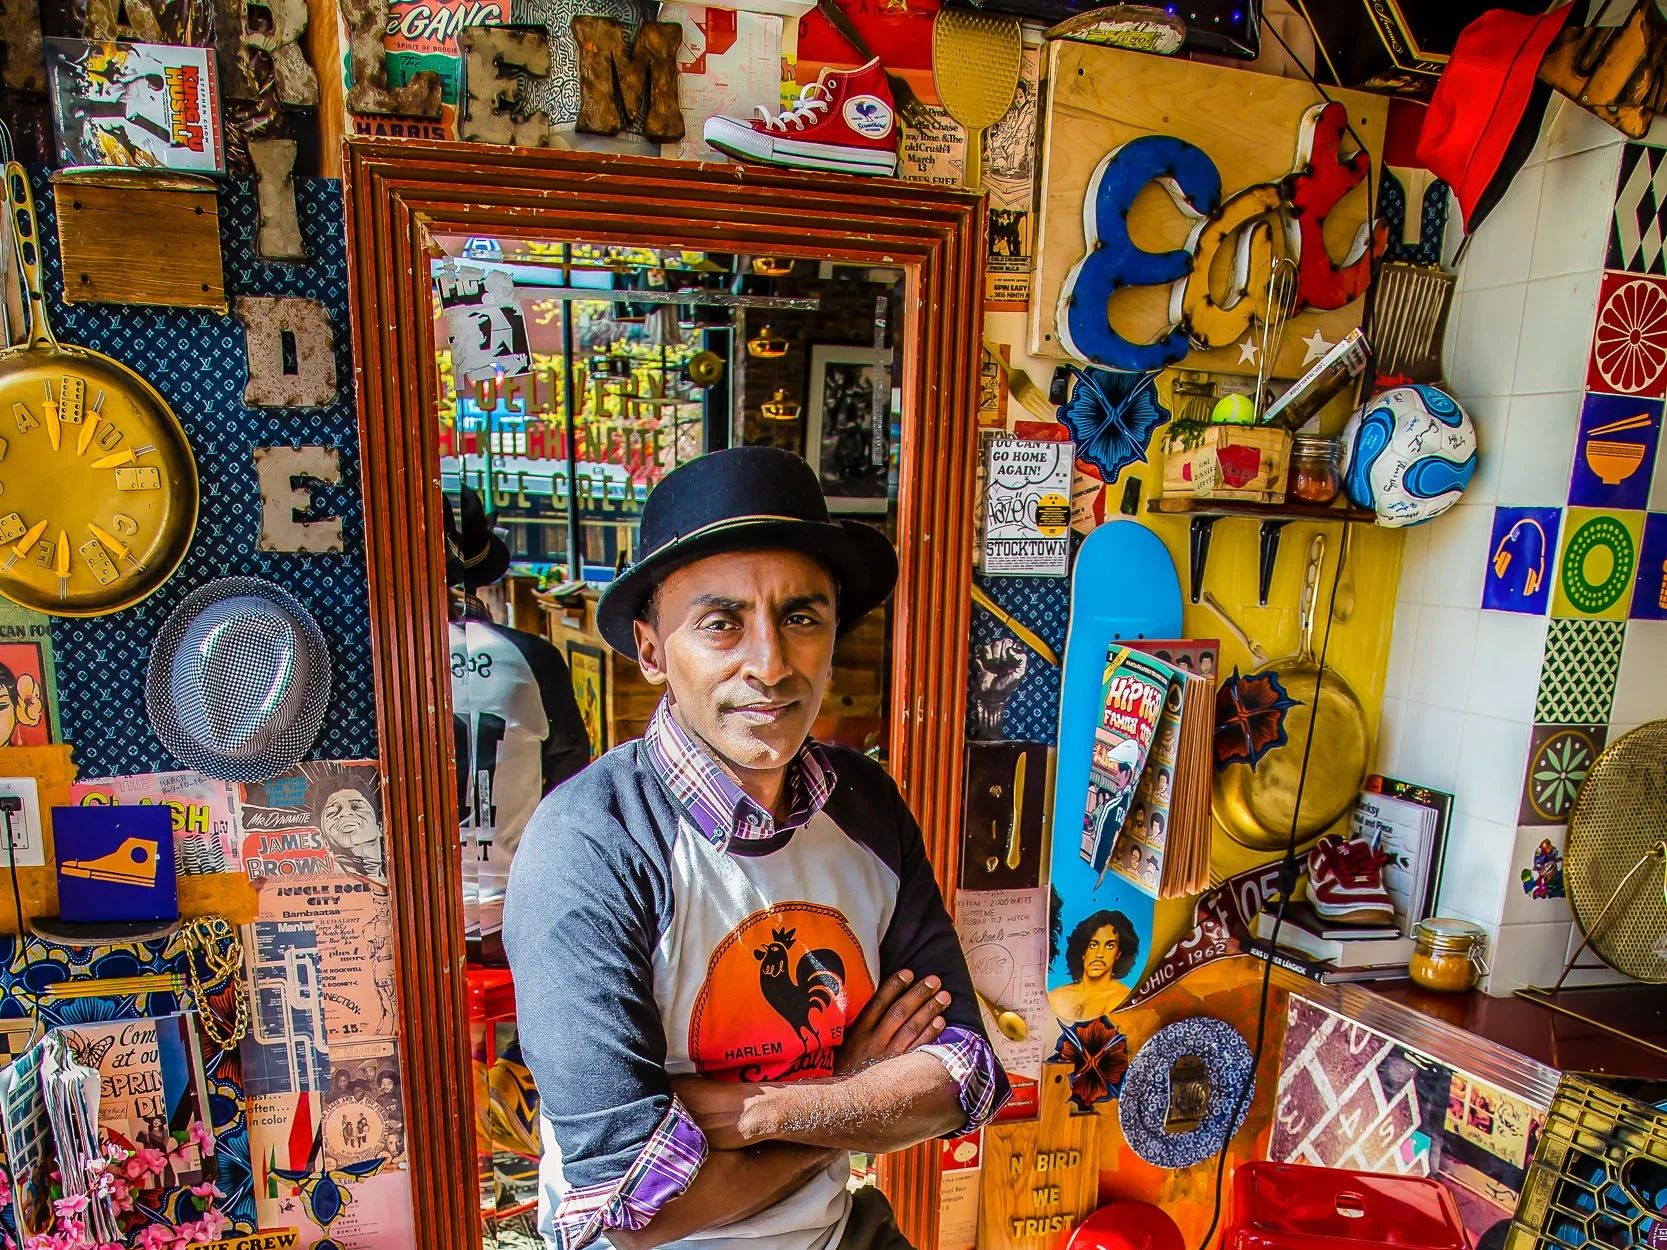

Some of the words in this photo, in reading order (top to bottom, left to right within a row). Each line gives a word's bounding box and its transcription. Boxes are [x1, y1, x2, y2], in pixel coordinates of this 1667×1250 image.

[181, 65, 200, 125] KUNG
[164, 66, 188, 147] HUSTLE
[186, 122, 204, 153] FU
[356, 121, 447, 140] HARRIS
[907, 153, 936, 164] March
[917, 164, 927, 173] 13
[1058, 100, 1390, 373] Eat
[475, 421, 666, 468] KITCHNETTE
[992, 451, 1009, 462] GO
[1012, 452, 1048, 463] HOME
[997, 465, 1042, 477] AGAIN!
[551, 471, 656, 513] CREA
[986, 541, 1067, 557] STOCKTOWN
[159, 773, 187, 787] MARCH
[259, 832, 322, 855] JAMES
[246, 855, 334, 881] BROWN
[306, 896, 341, 906] CITY
[282, 908, 341, 919] Bambaataa
[329, 949, 351, 959] plus
[111, 1050, 138, 1069] at
[724, 1041, 783, 1061] HARLEM
[261, 1115, 288, 1126] color
[1035, 1149, 1081, 1173] BIRD
[1032, 1184, 1060, 1208] WE
[1012, 1214, 1075, 1239] TRUST
